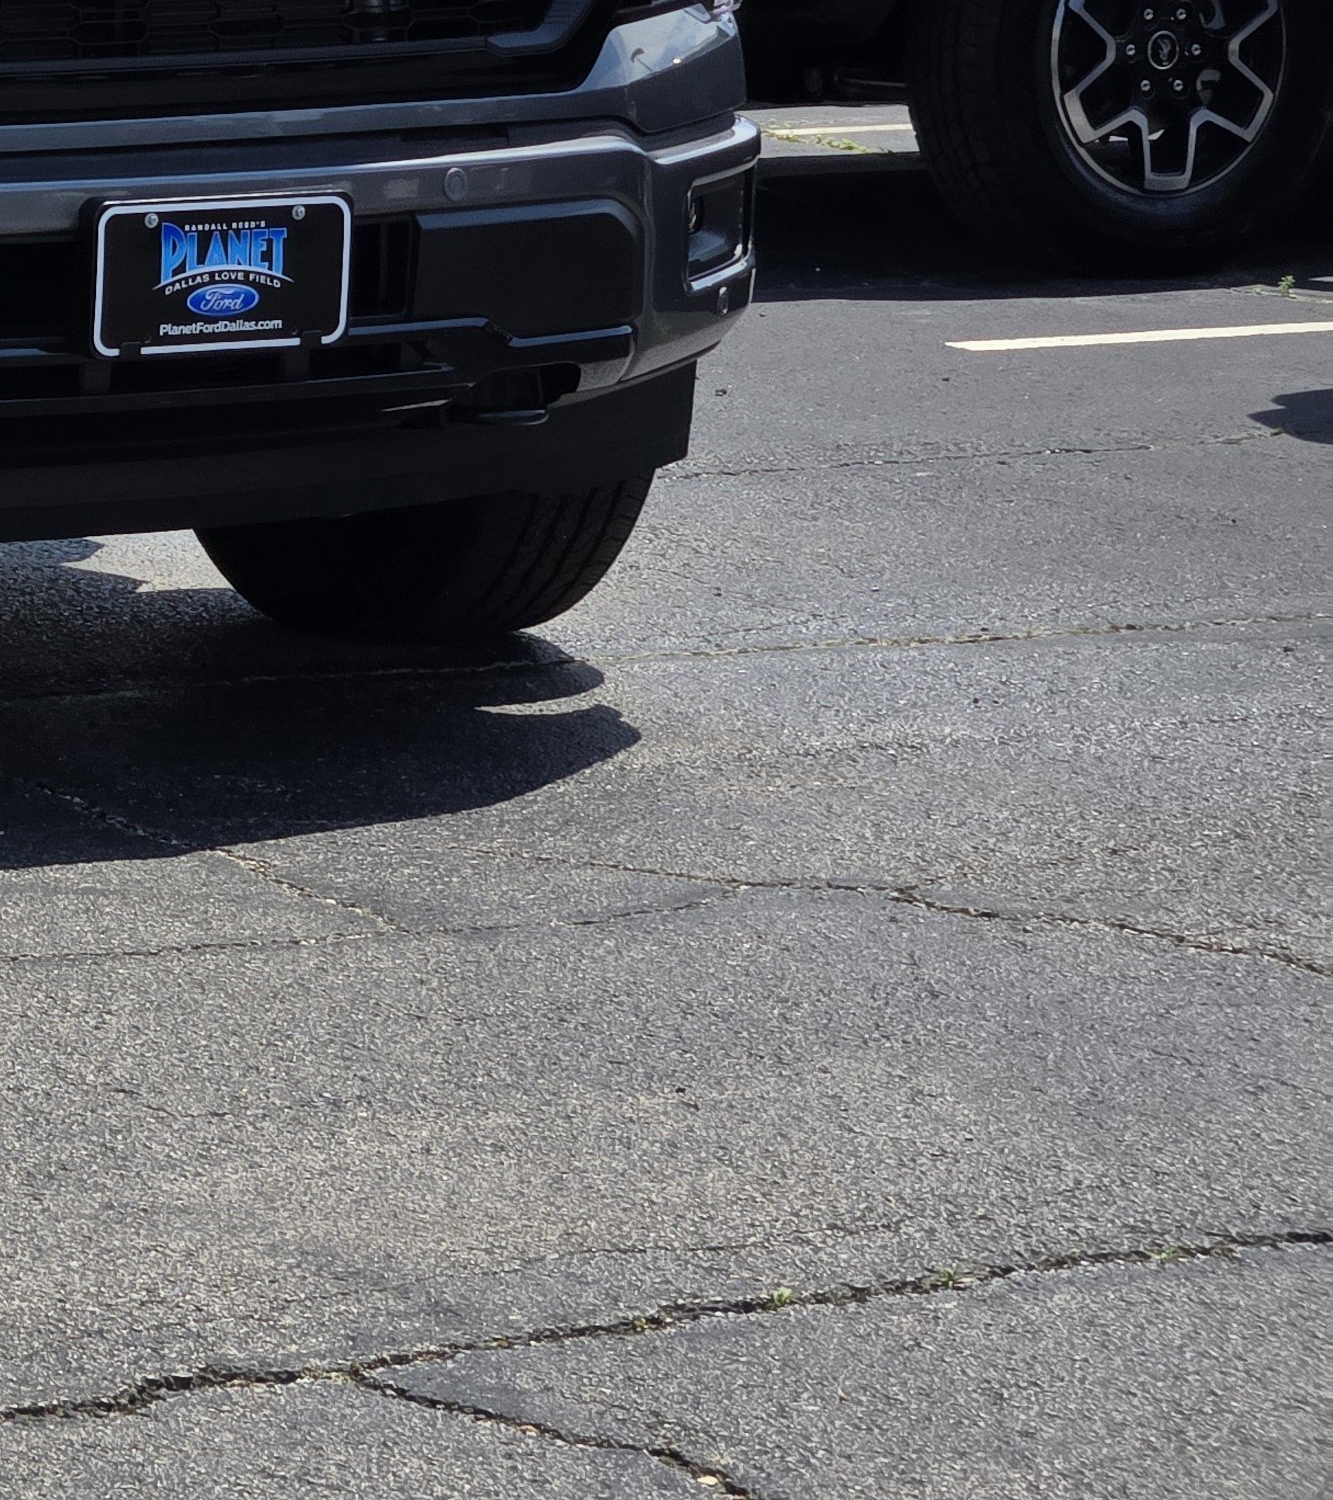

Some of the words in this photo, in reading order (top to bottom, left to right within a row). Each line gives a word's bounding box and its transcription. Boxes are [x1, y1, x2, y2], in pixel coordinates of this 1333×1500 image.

[160, 221, 288, 282] PLANET
[164, 273, 210, 296] DALLAS
[215, 271, 245, 281] LOVE
[249, 273, 282, 288] FIELD
[199, 288, 245, 311] Ford
[159, 319, 283, 336] PlanetFordDallas.com
